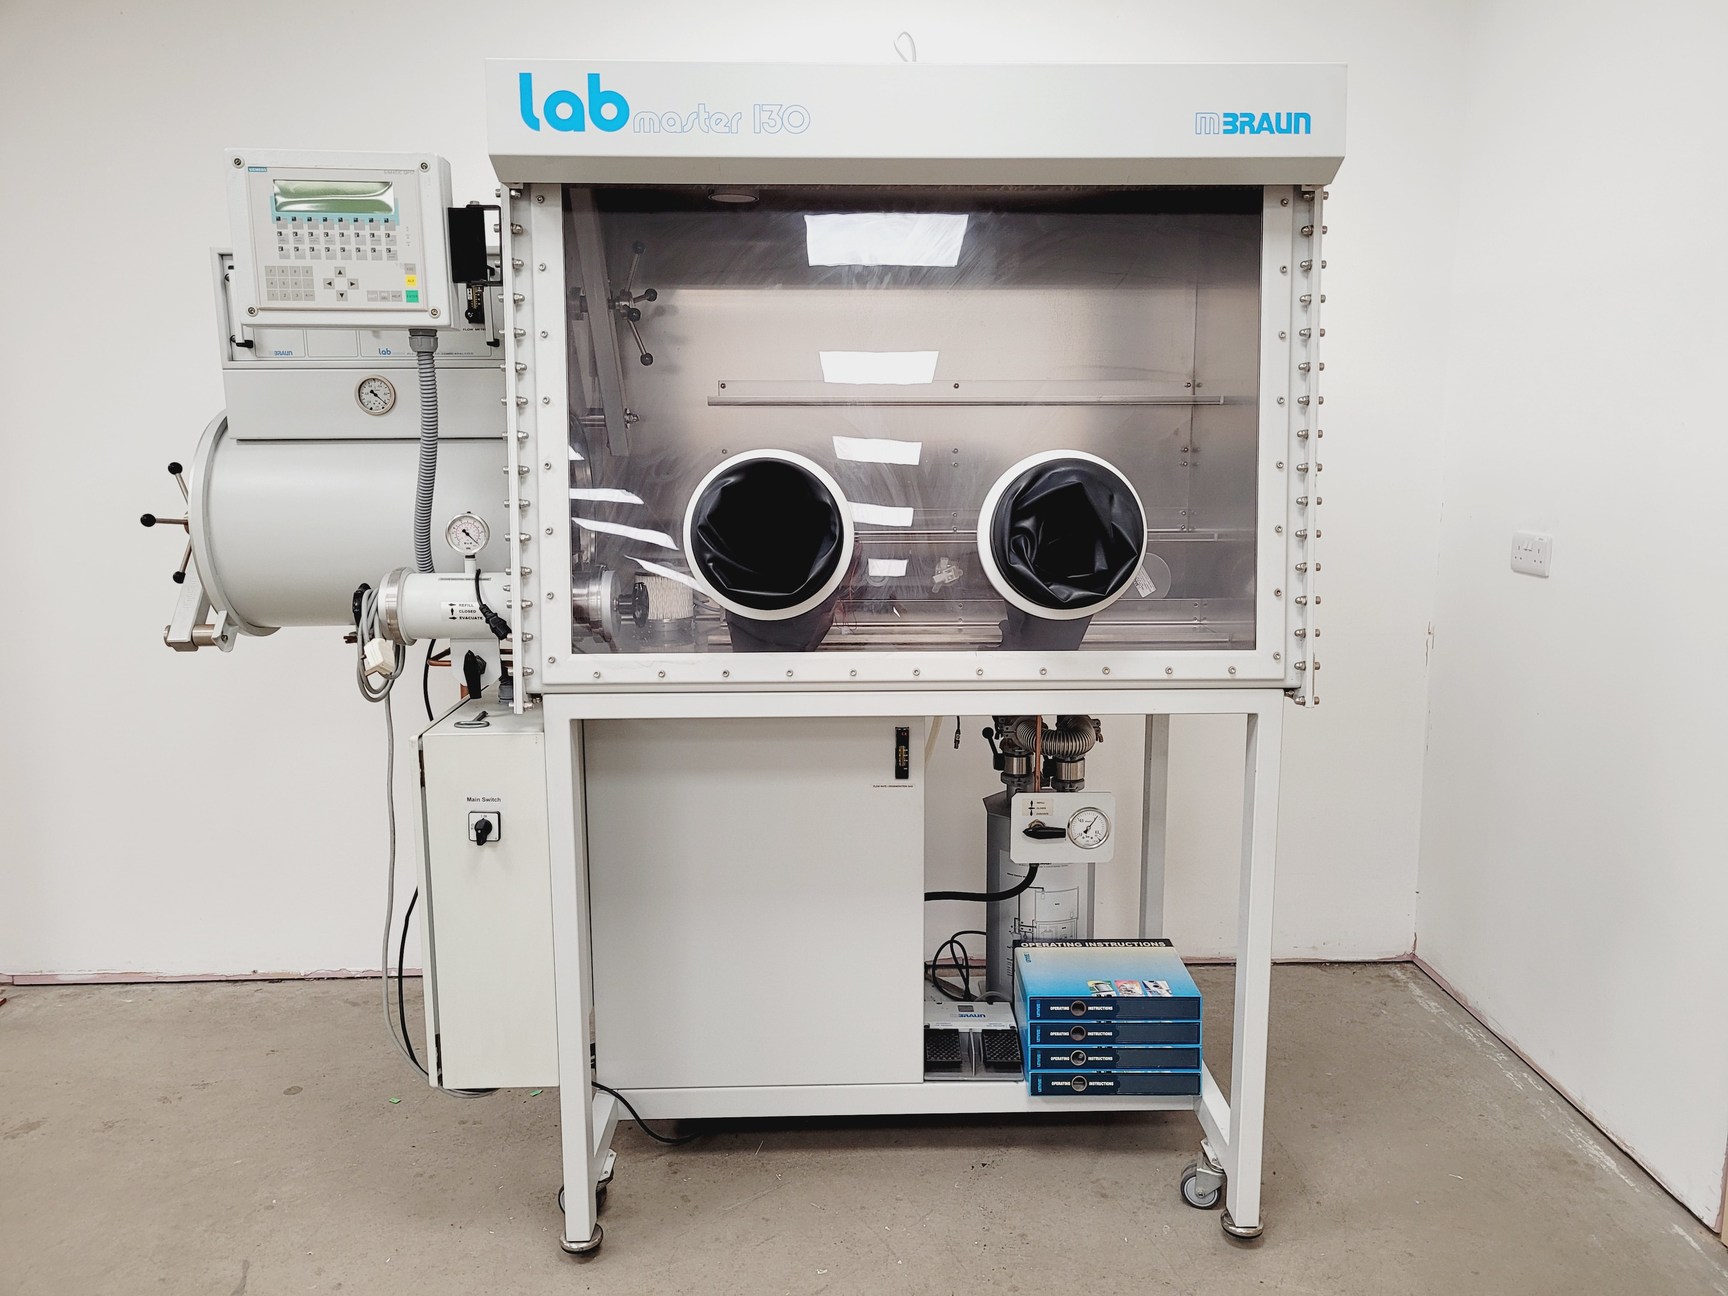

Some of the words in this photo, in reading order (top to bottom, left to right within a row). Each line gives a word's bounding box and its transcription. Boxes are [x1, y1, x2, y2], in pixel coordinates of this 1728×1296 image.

[519, 72, 630, 132] lab
[633, 103, 742, 134] master
[753, 104, 811, 134] 130
